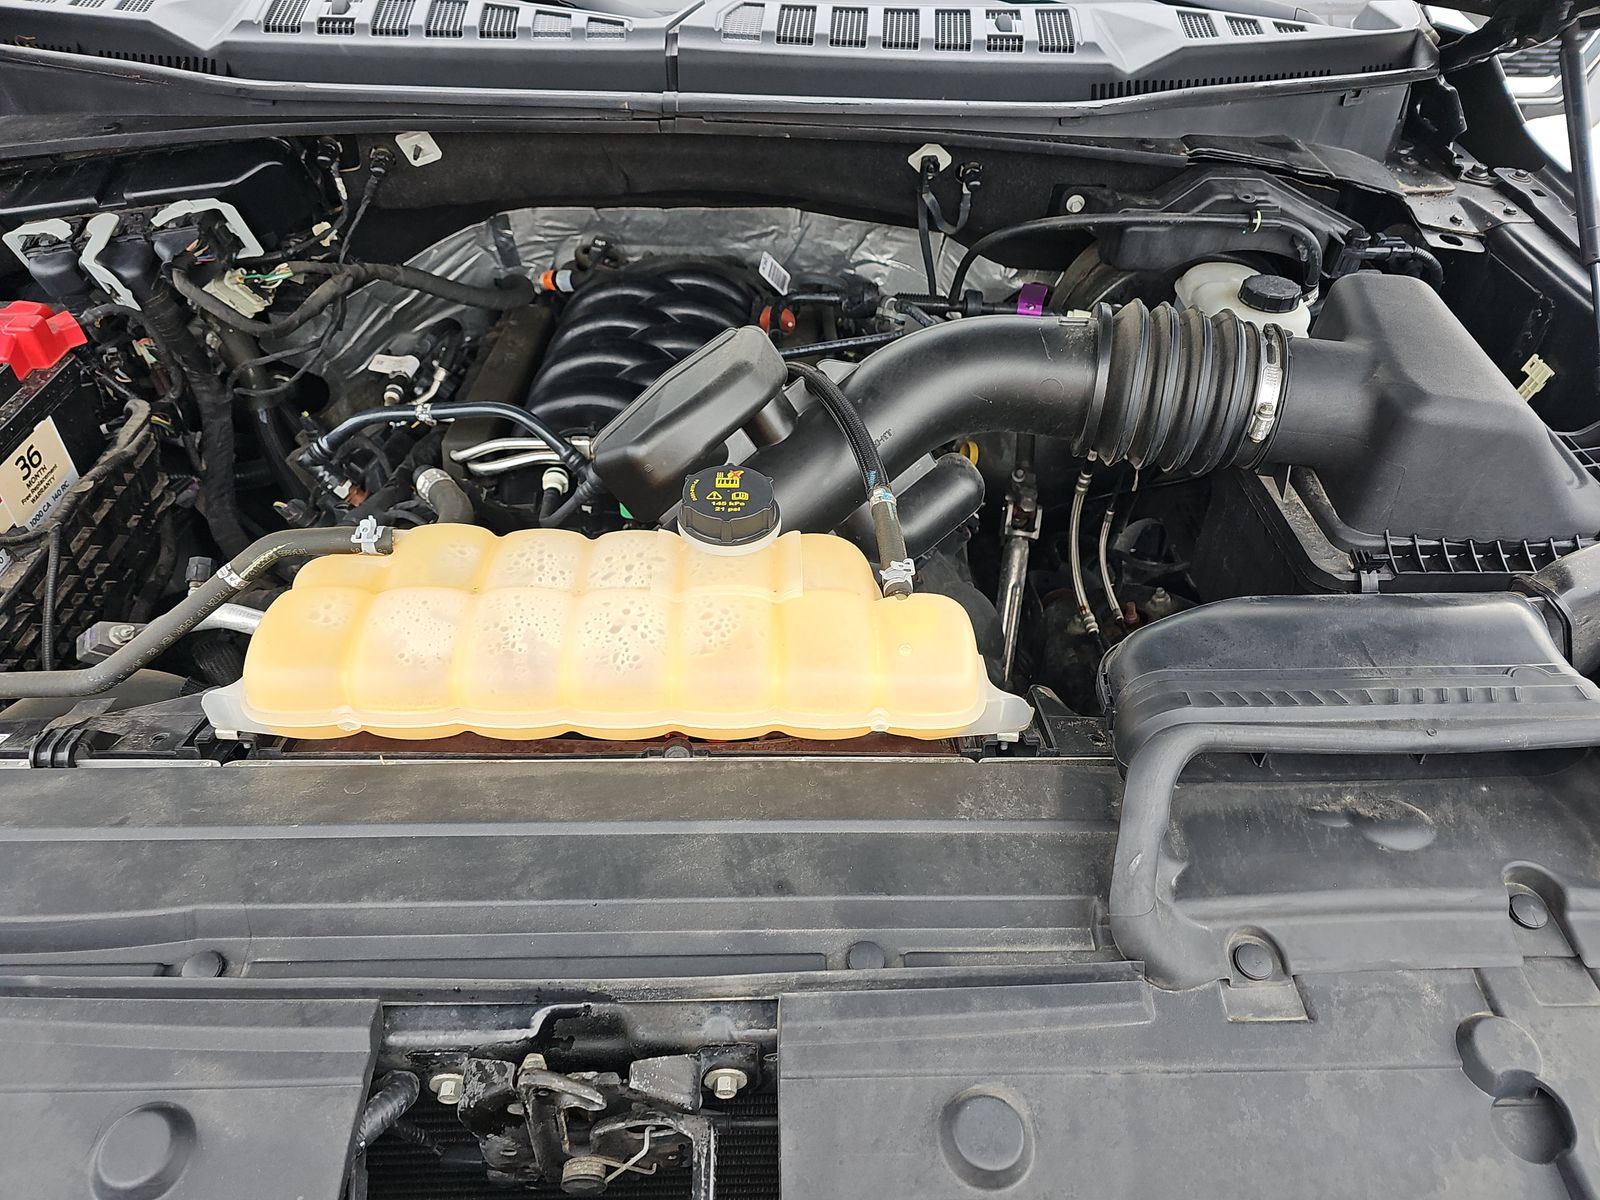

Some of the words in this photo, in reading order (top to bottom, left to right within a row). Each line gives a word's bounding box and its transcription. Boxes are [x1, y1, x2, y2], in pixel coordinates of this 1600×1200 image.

[15, 444, 42, 481] 36
[26, 465, 47, 489] MONTH
[21, 494, 31, 505] Free
[30, 464, 58, 495] Replacement
[30, 475, 56, 504] WARRANTY
[29, 510, 44, 528] 1000
[42, 501, 52, 513] CA
[51, 487, 62, 502] 140
[61, 480, 70, 491] RC
